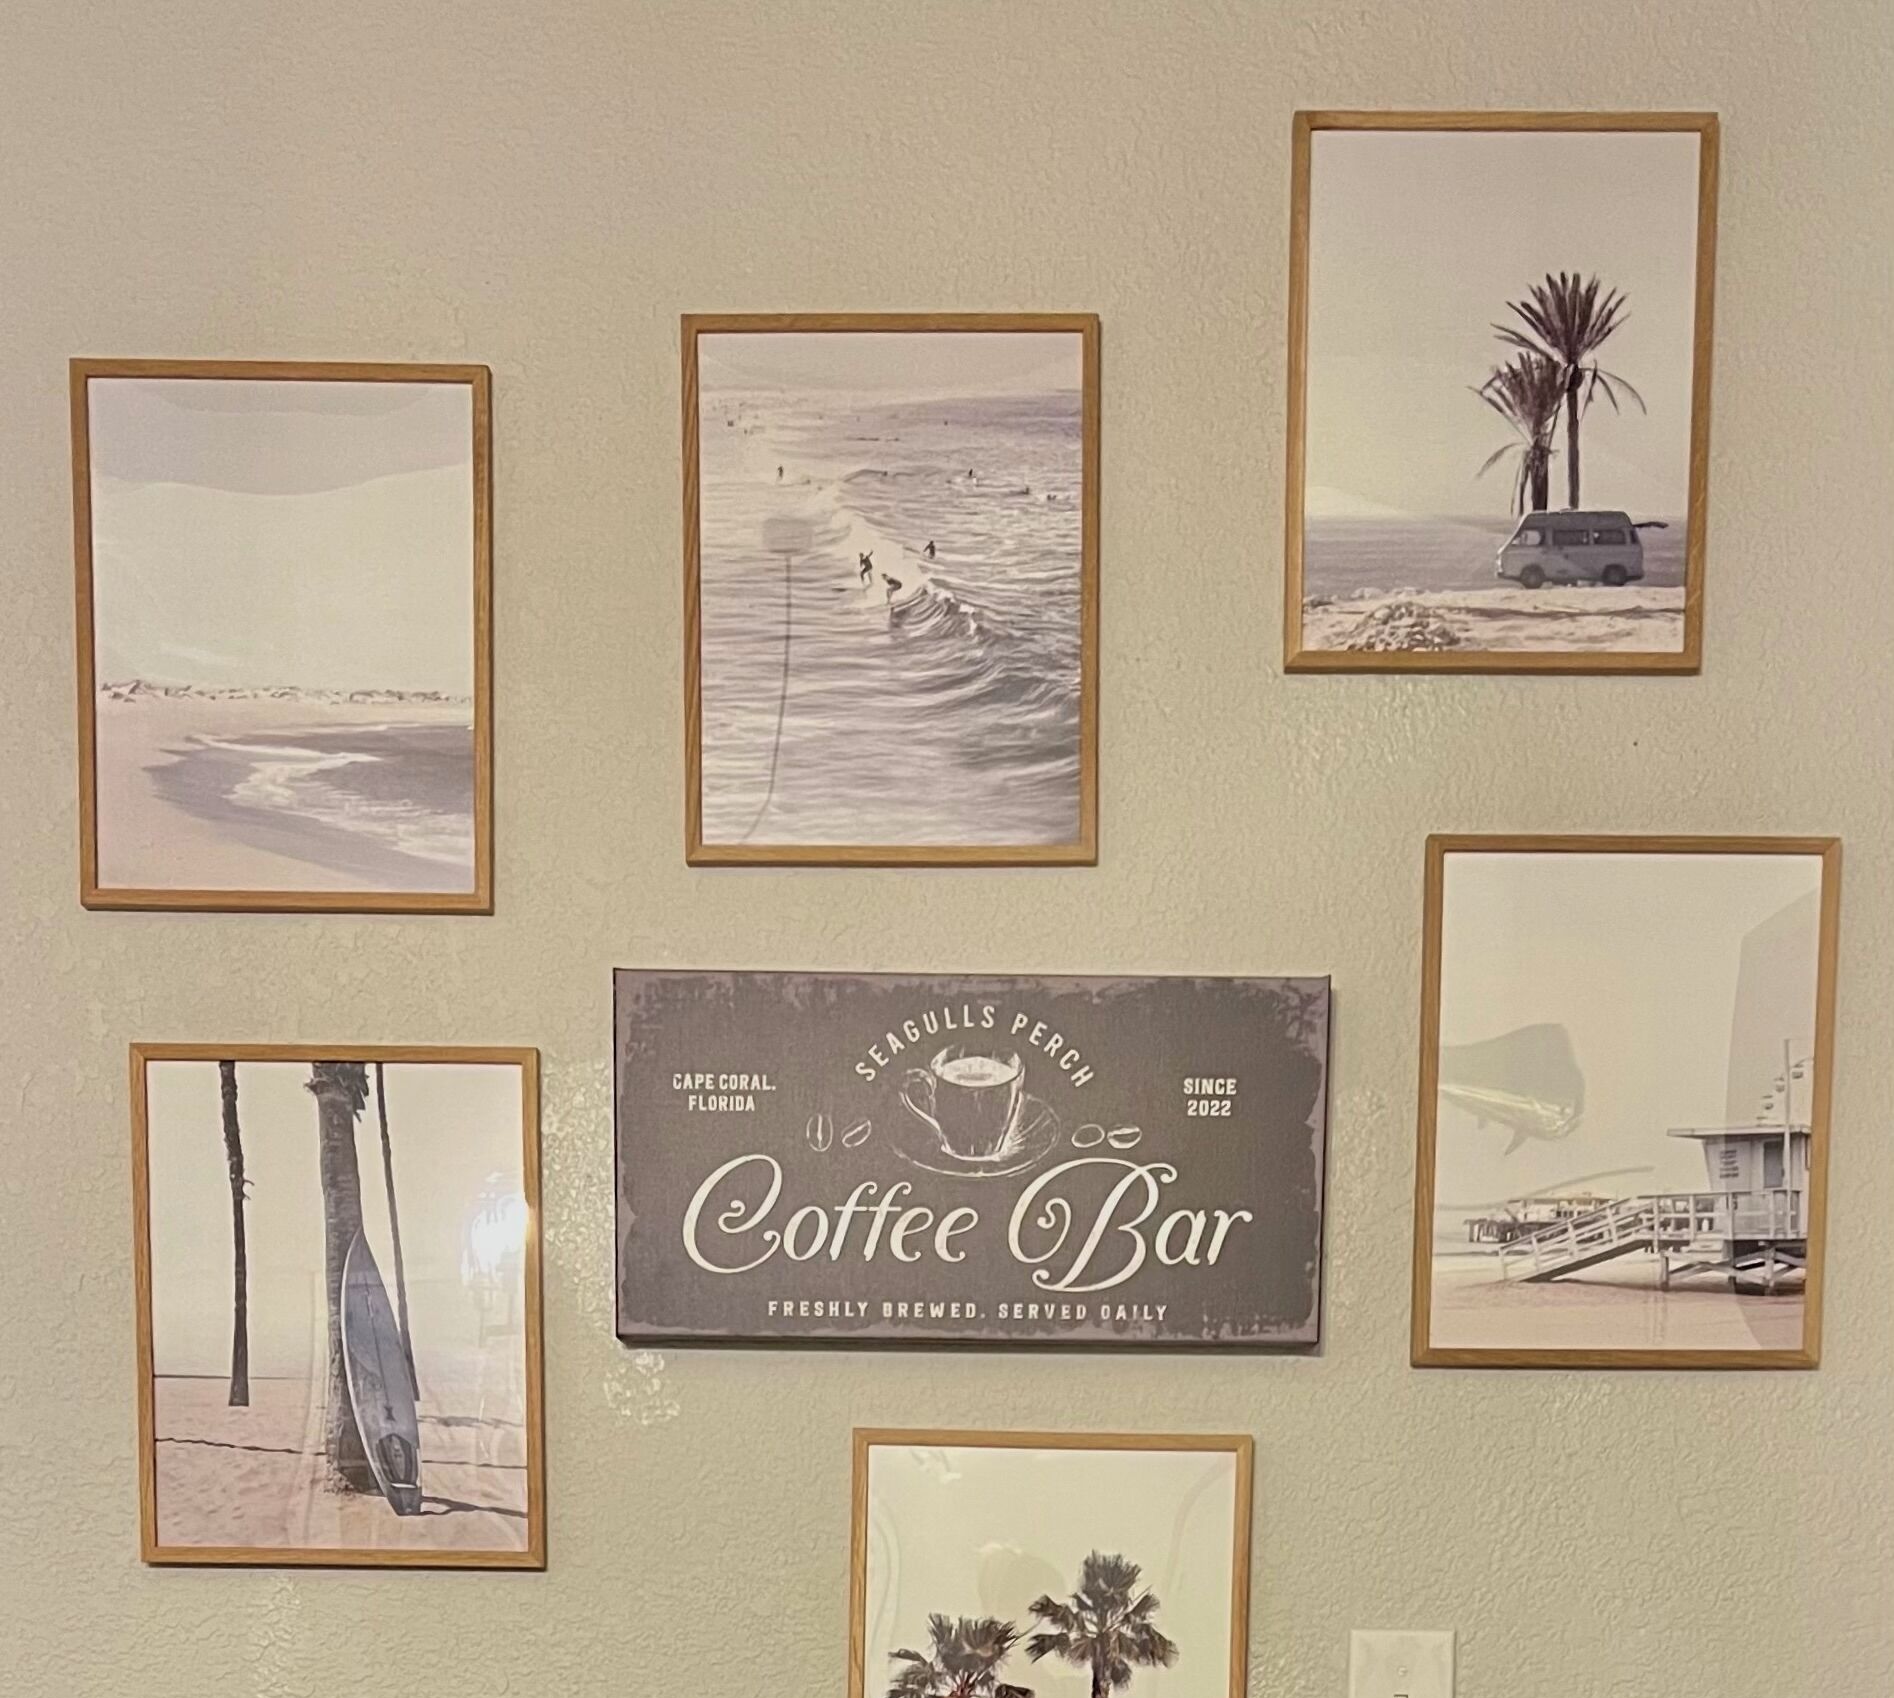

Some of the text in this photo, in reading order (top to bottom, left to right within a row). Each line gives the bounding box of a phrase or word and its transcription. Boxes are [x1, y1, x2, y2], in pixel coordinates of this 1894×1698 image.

[855, 1004, 1094, 1088] SEAGULLS PERCH
[672, 1073, 715, 1090] CAPE
[1183, 1077, 1237, 1095] SINCE
[688, 1094, 755, 1111] FLORIDA
[1187, 1099, 1232, 1117] 2022
[682, 1154, 1253, 1293] Coffee Bar
[768, 1300, 868, 1318] FRESHLY
[998, 1302, 1087, 1320] SERVED
[1101, 1304, 1169, 1322] DAILY
